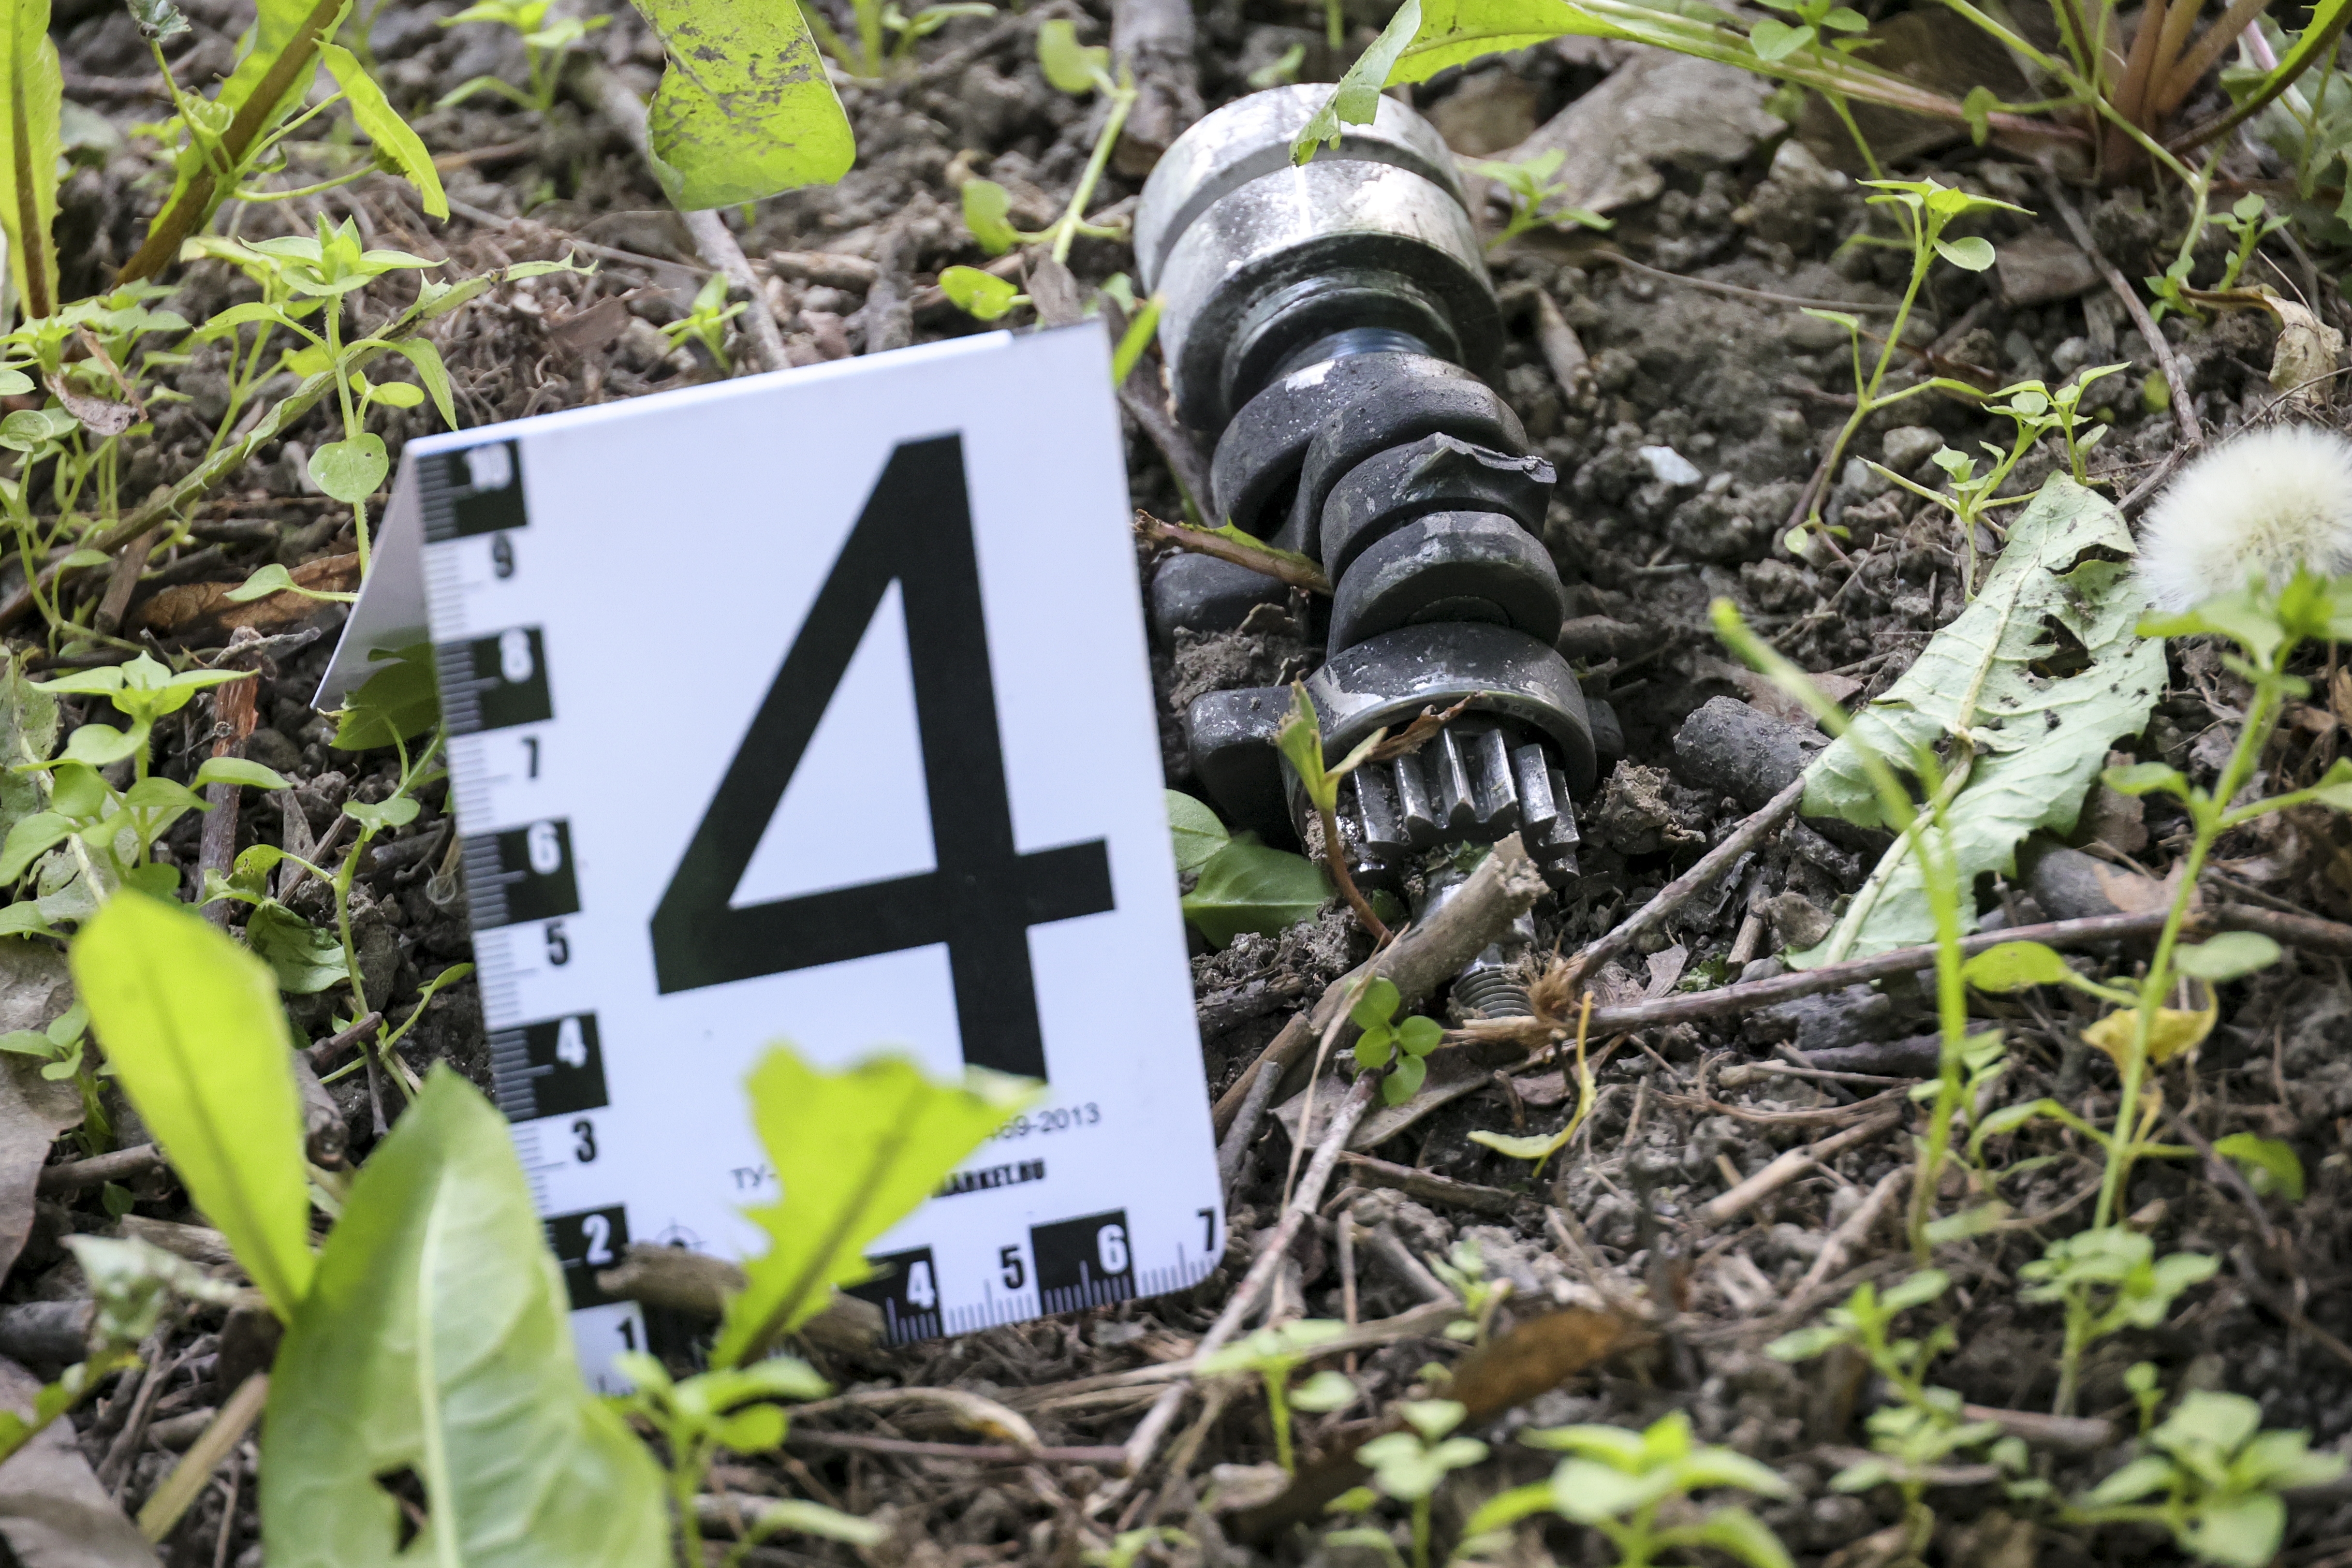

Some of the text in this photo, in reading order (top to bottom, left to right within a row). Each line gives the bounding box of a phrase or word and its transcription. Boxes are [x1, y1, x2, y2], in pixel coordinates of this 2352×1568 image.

[492, 533, 514, 579] 9
[499, 629, 533, 683] 8
[521, 736, 539, 780] 7
[649, 430, 1116, 1084] 4
[528, 821, 561, 875] 6
[544, 920, 570, 966] 5
[556, 1016, 588, 1068] 4
[573, 1117, 597, 1162] 3
[582, 1214, 613, 1264] 2
[906, 1207, 1215, 1310] 4 5 6 7
[617, 1317, 635, 1352] 1
